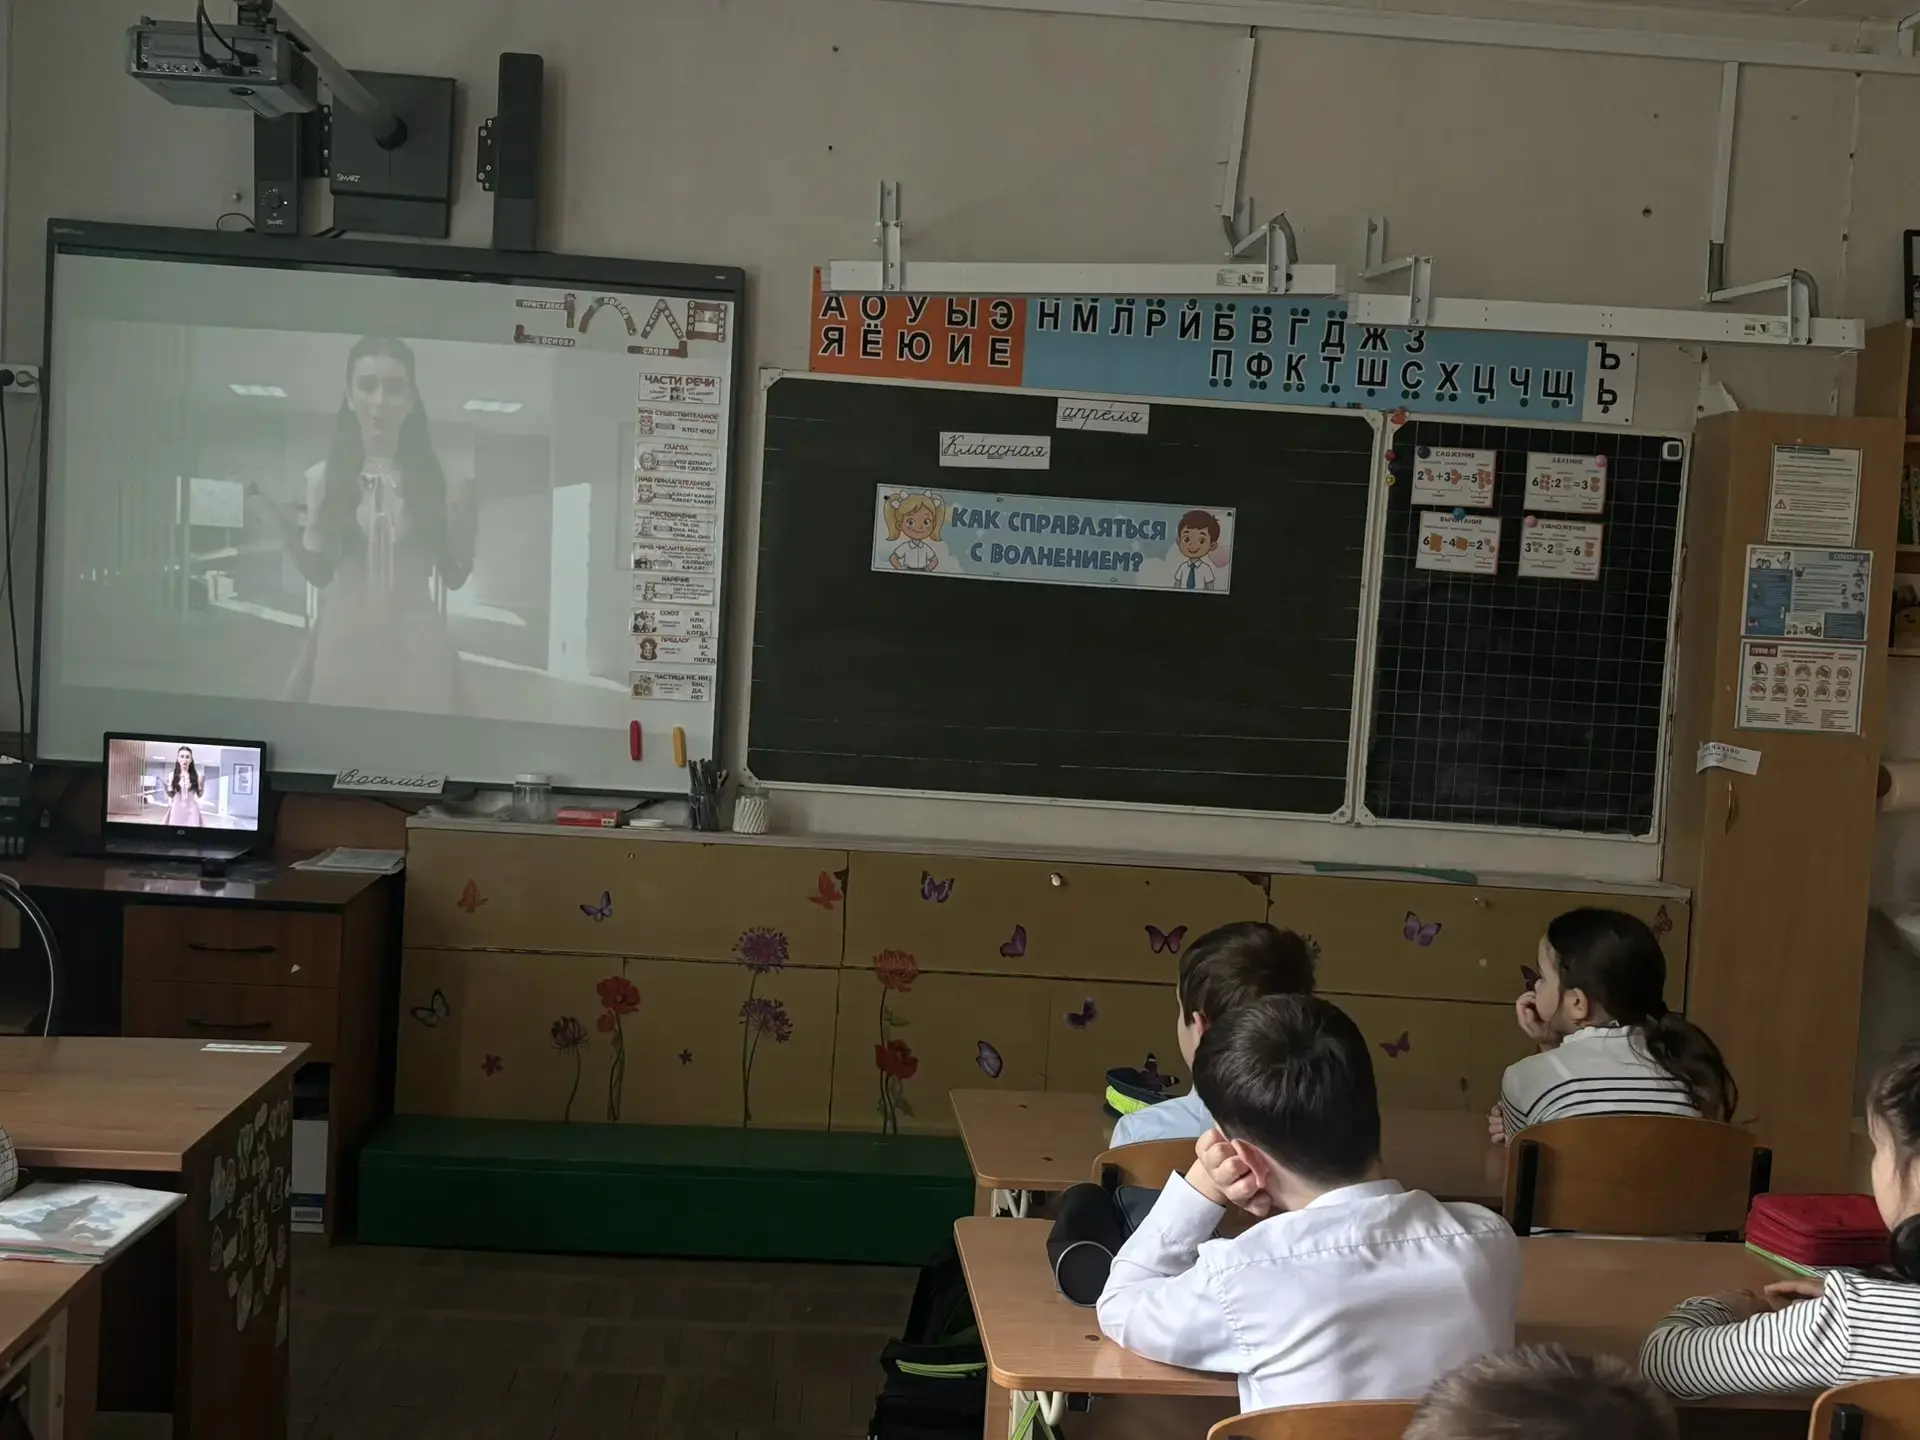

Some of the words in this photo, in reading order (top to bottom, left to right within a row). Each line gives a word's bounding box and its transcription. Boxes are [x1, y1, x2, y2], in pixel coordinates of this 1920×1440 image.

[337, 174, 360, 182] SMART
[522, 300, 565, 310] ПРИСТАВКА
[603, 297, 630, 320] КОРЕНЬ
[822, 296, 845, 318] А
[862, 296, 886, 320] О
[907, 296, 928, 322] У
[947, 298, 976, 327] Ы
[991, 300, 1012, 329] Э
[1038, 301, 1060, 330] Н
[1073, 303, 1098, 332] М
[1110, 307, 1133, 334] Л
[1146, 308, 1166, 336] Р
[1179, 302, 1200, 339] Й
[1213, 313, 1234, 340] Б
[1251, 315, 1272, 343] В
[1289, 317, 1308, 345] Г
[1321, 320, 1345, 354] Д
[1360, 328, 1388, 351] Ж
[1405, 330, 1424, 353] З
[541, 337, 574, 347] ОСНОВА
[643, 347, 670, 356] СЛОВА
[820, 326, 843, 355] Я
[862, 322, 881, 357] Ё
[899, 332, 930, 360] Ю
[949, 335, 970, 364] И
[989, 337, 1010, 366] Е
[1594, 342, 1620, 370] Ъ
[644, 374, 682, 386] ЧАСТИ
[685, 377, 715, 388] РЕЧИ
[1211, 349, 1232, 377] П
[1246, 352, 1272, 379] Ф
[1285, 353, 1306, 381] К
[1322, 356, 1342, 383] Т
[1357, 358, 1388, 386] Ш
[1402, 361, 1423, 389] С
[1437, 363, 1460, 391] Х
[1473, 365, 1494, 399] Ц
[1510, 368, 1530, 396] Ч
[1542, 370, 1573, 404] Щ
[1597, 378, 1617, 406] Ь
[655, 410, 718, 420] СУЩЕСТВИТЕЛЬНОЕ
[1435, 451, 1475, 459] СЛОЖЕНИЕ
[1551, 457, 1583, 465] ДЕЛЕНИЕ
[654, 478, 711, 487] ПРИЛАГАТЕЛЬНОЕ
[649, 511, 697, 519] МЕСТОИМЕНИЕ
[1440, 516, 1482, 525] ВЫЧИТАНИЕ
[951, 507, 1000, 529] КАК
[1008, 511, 1167, 540] СПРАВЛЯТЬСЯ
[1540, 523, 1586, 531] УМНОЖЕНИЕ
[970, 542, 983, 562] С
[990, 543, 1144, 572] ВОЛНЕНИЕМ?
